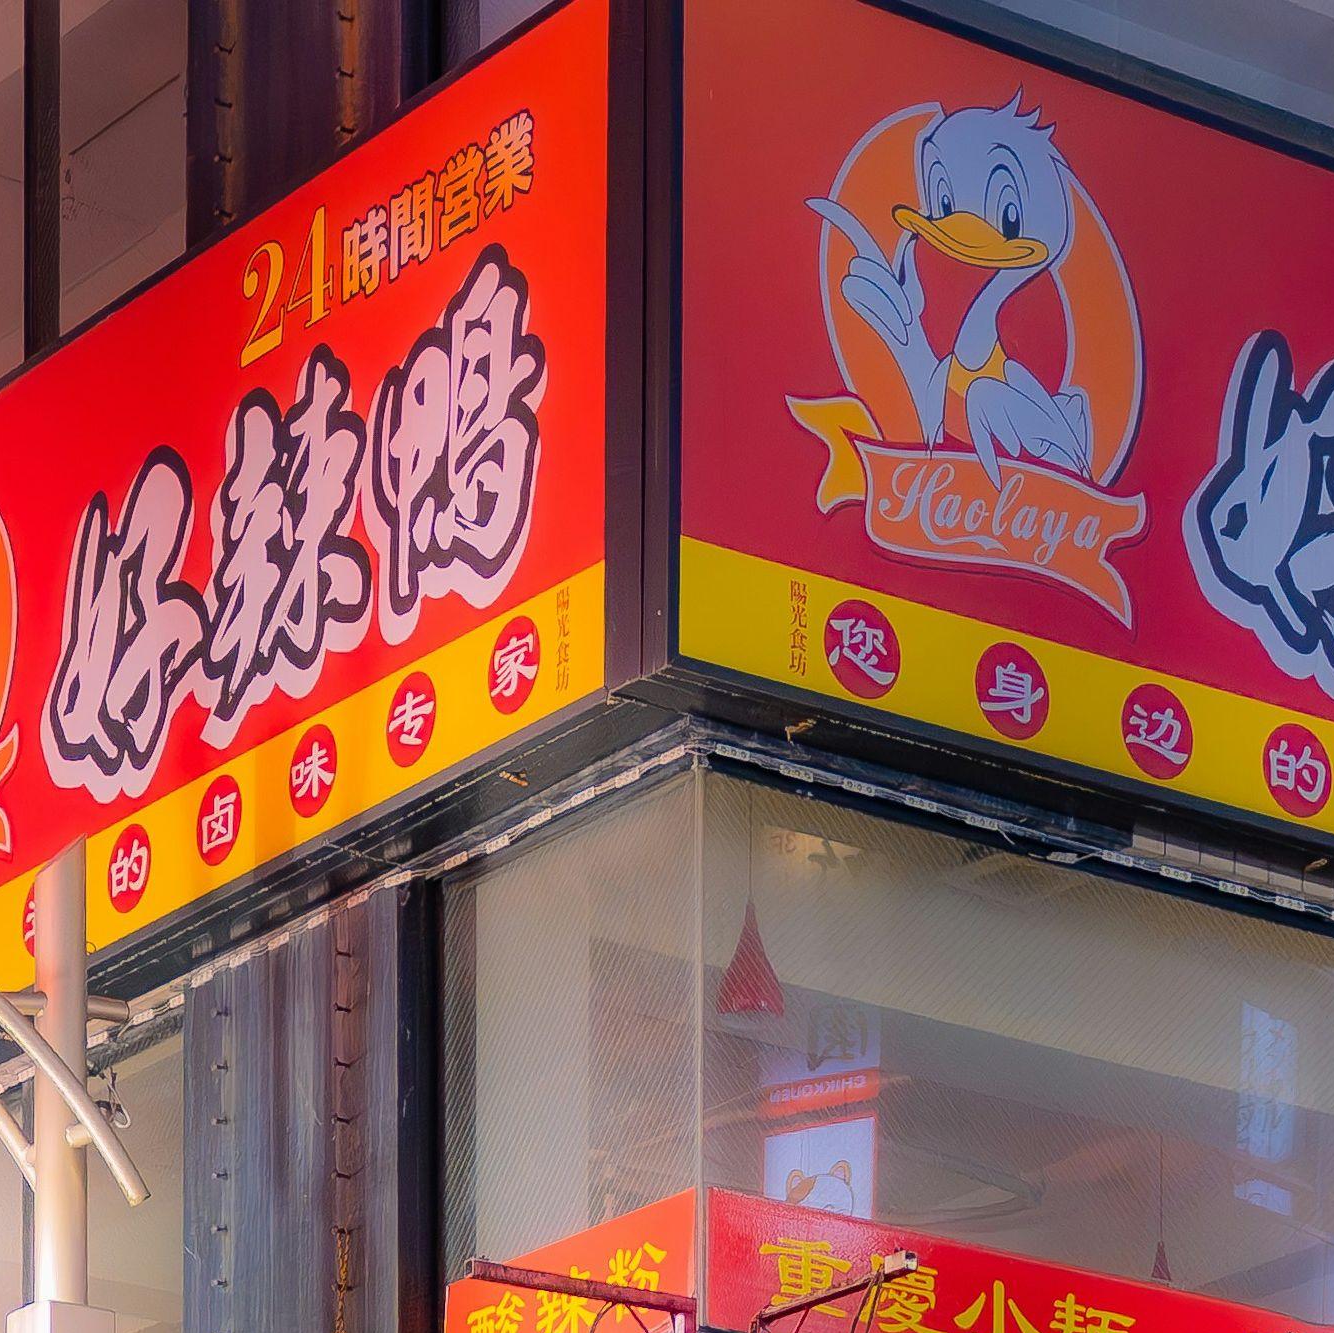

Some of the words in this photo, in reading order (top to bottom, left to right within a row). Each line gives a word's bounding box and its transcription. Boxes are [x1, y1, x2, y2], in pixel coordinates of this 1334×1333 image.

[239, 109, 535, 368] 24時間営業
[40, 244, 547, 804] 好辣鴨
[877, 462, 1101, 566] Haolaya
